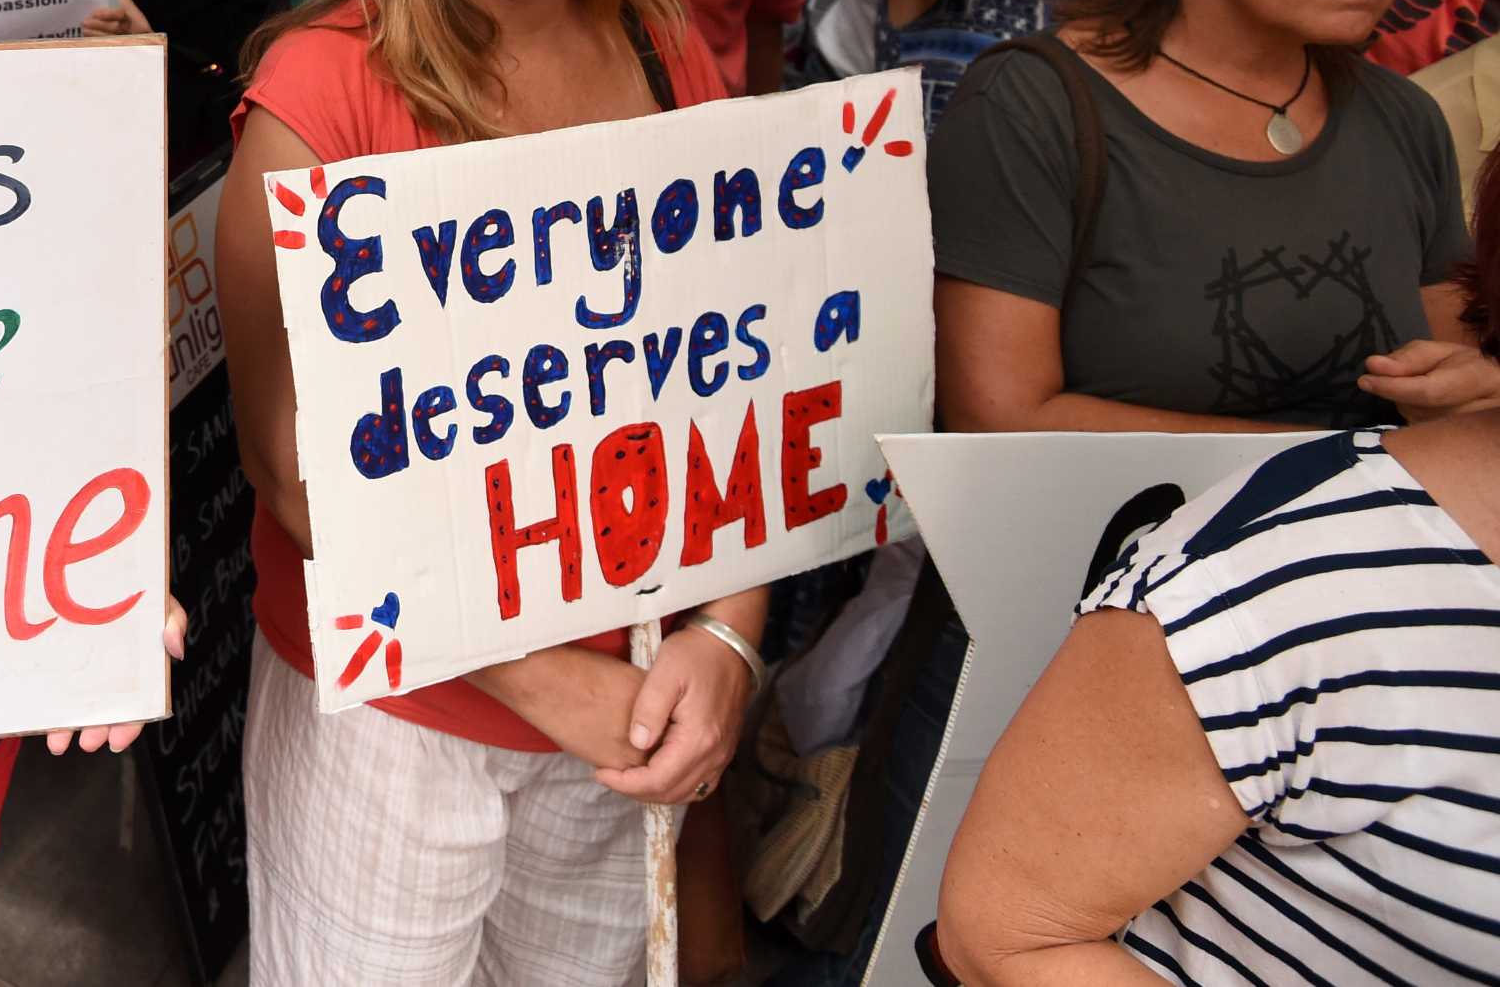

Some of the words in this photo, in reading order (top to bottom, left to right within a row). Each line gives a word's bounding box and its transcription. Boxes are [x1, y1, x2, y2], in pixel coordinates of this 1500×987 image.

[317, 145, 827, 344] Everyone
[349, 304, 772, 480] deserves
[814, 290, 861, 353] a
[486, 380, 848, 621] HOME
